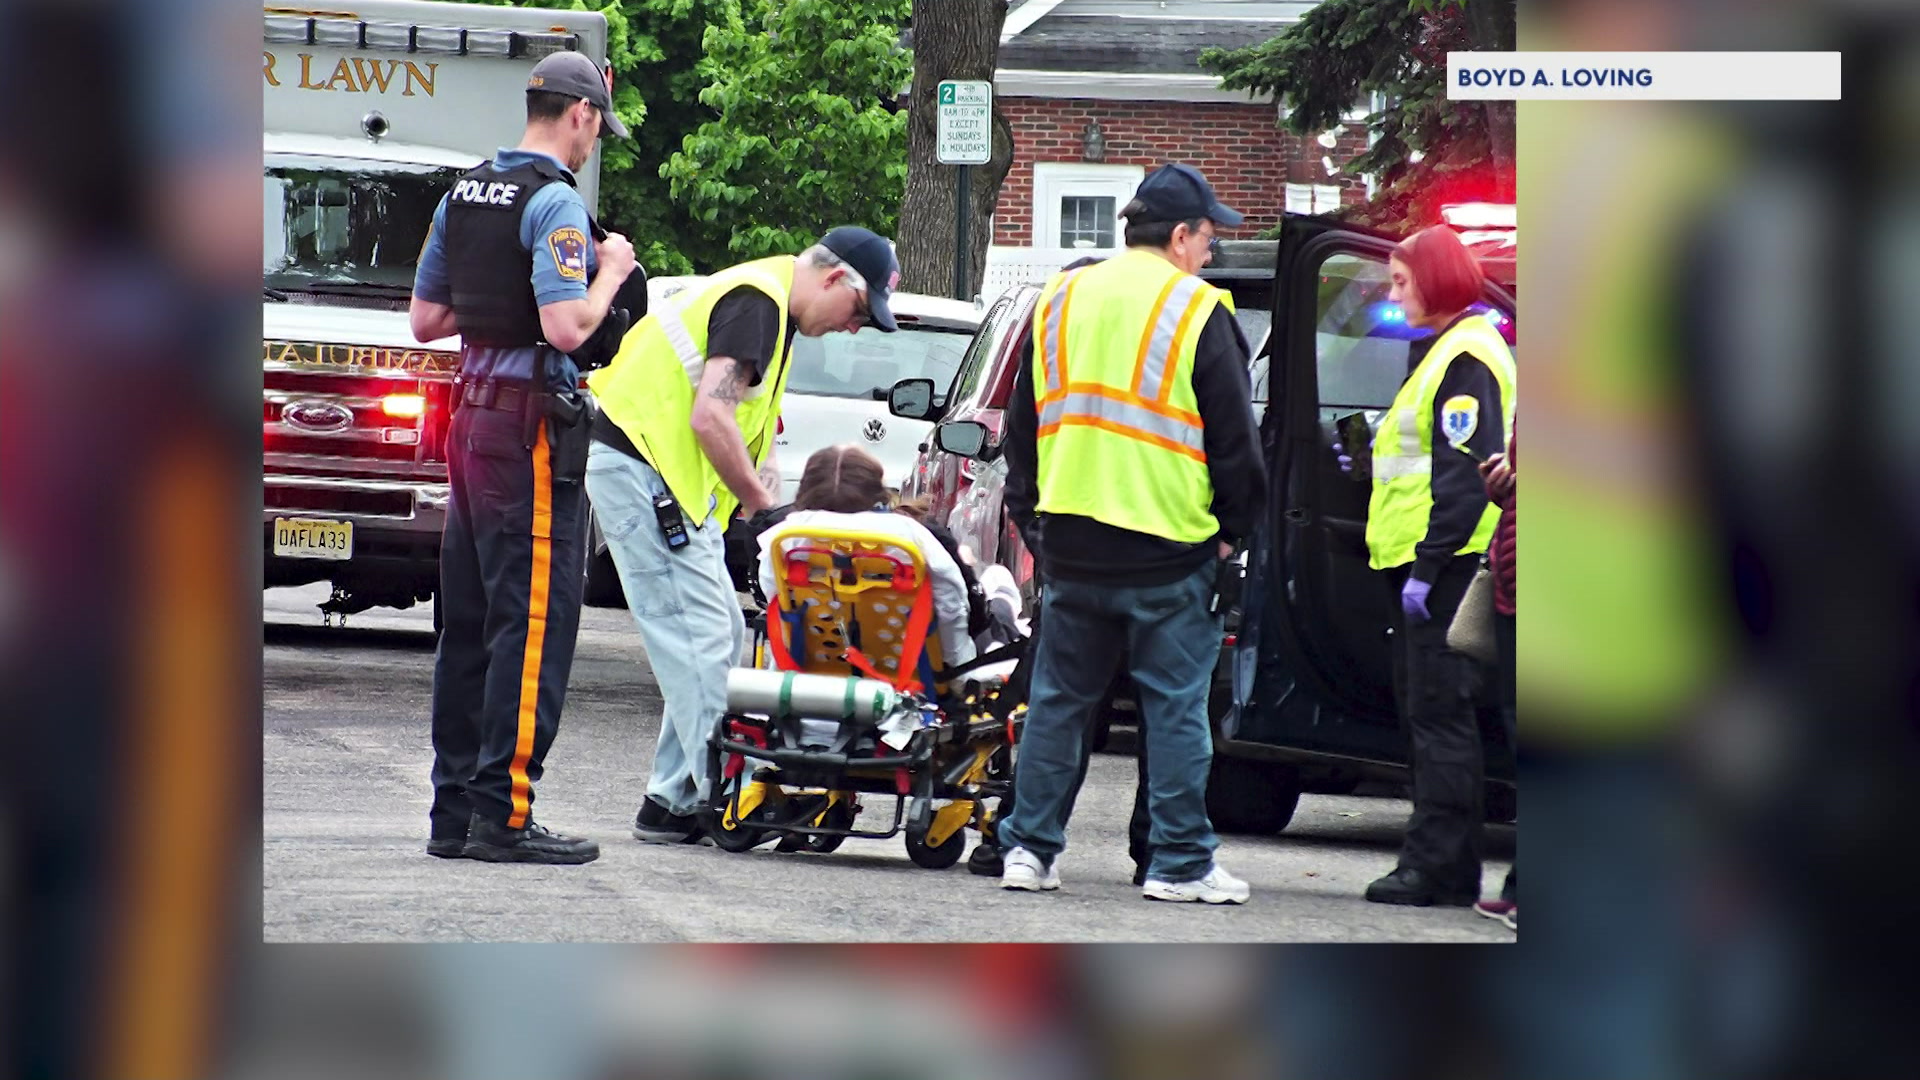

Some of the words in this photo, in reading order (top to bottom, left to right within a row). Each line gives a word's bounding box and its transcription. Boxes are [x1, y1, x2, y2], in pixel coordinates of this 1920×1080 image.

[297, 53, 439, 98] LAWN
[943, 86, 953, 103] 2
[957, 95, 984, 103] PARKING
[944, 108, 958, 116] 8AM
[961, 108, 969, 116] TO
[949, 120, 979, 129] EXCEPT
[947, 132, 982, 141] SUNDAYS
[950, 144, 986, 153] HOLIDAYS
[451, 179, 520, 205] POLICE
